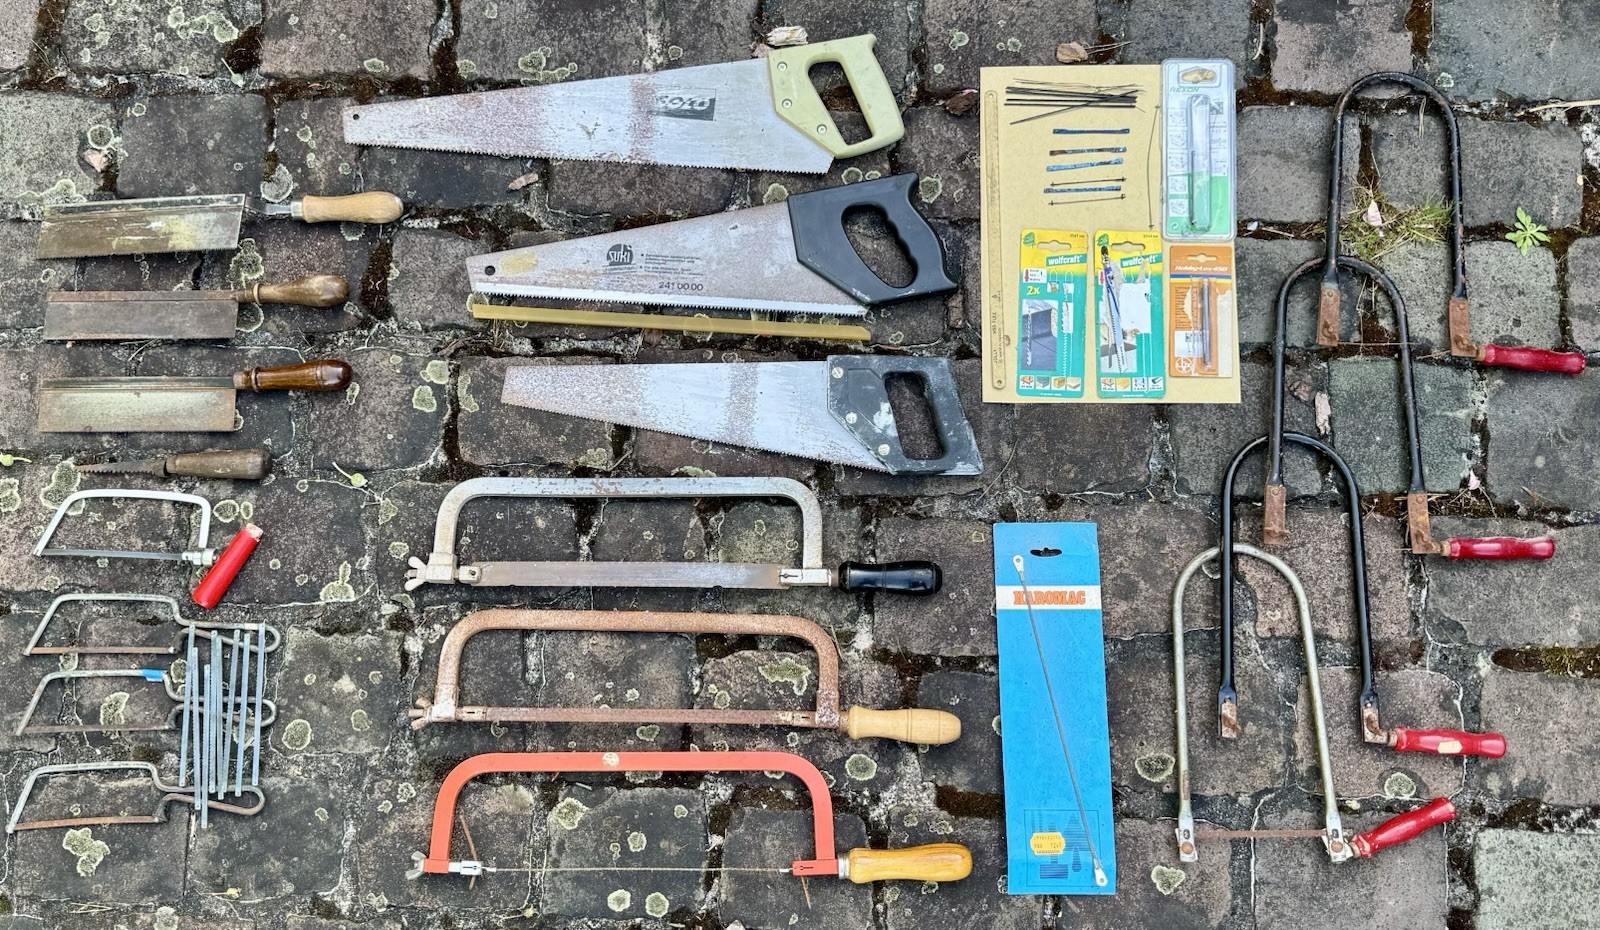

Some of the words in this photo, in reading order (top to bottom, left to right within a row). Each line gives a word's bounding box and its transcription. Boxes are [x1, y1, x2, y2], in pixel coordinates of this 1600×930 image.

[1048, 254, 1081, 265] wolfcraft
[1027, 285, 1040, 295] 2x
[1013, 590, 1086, 606] HAROMAC
